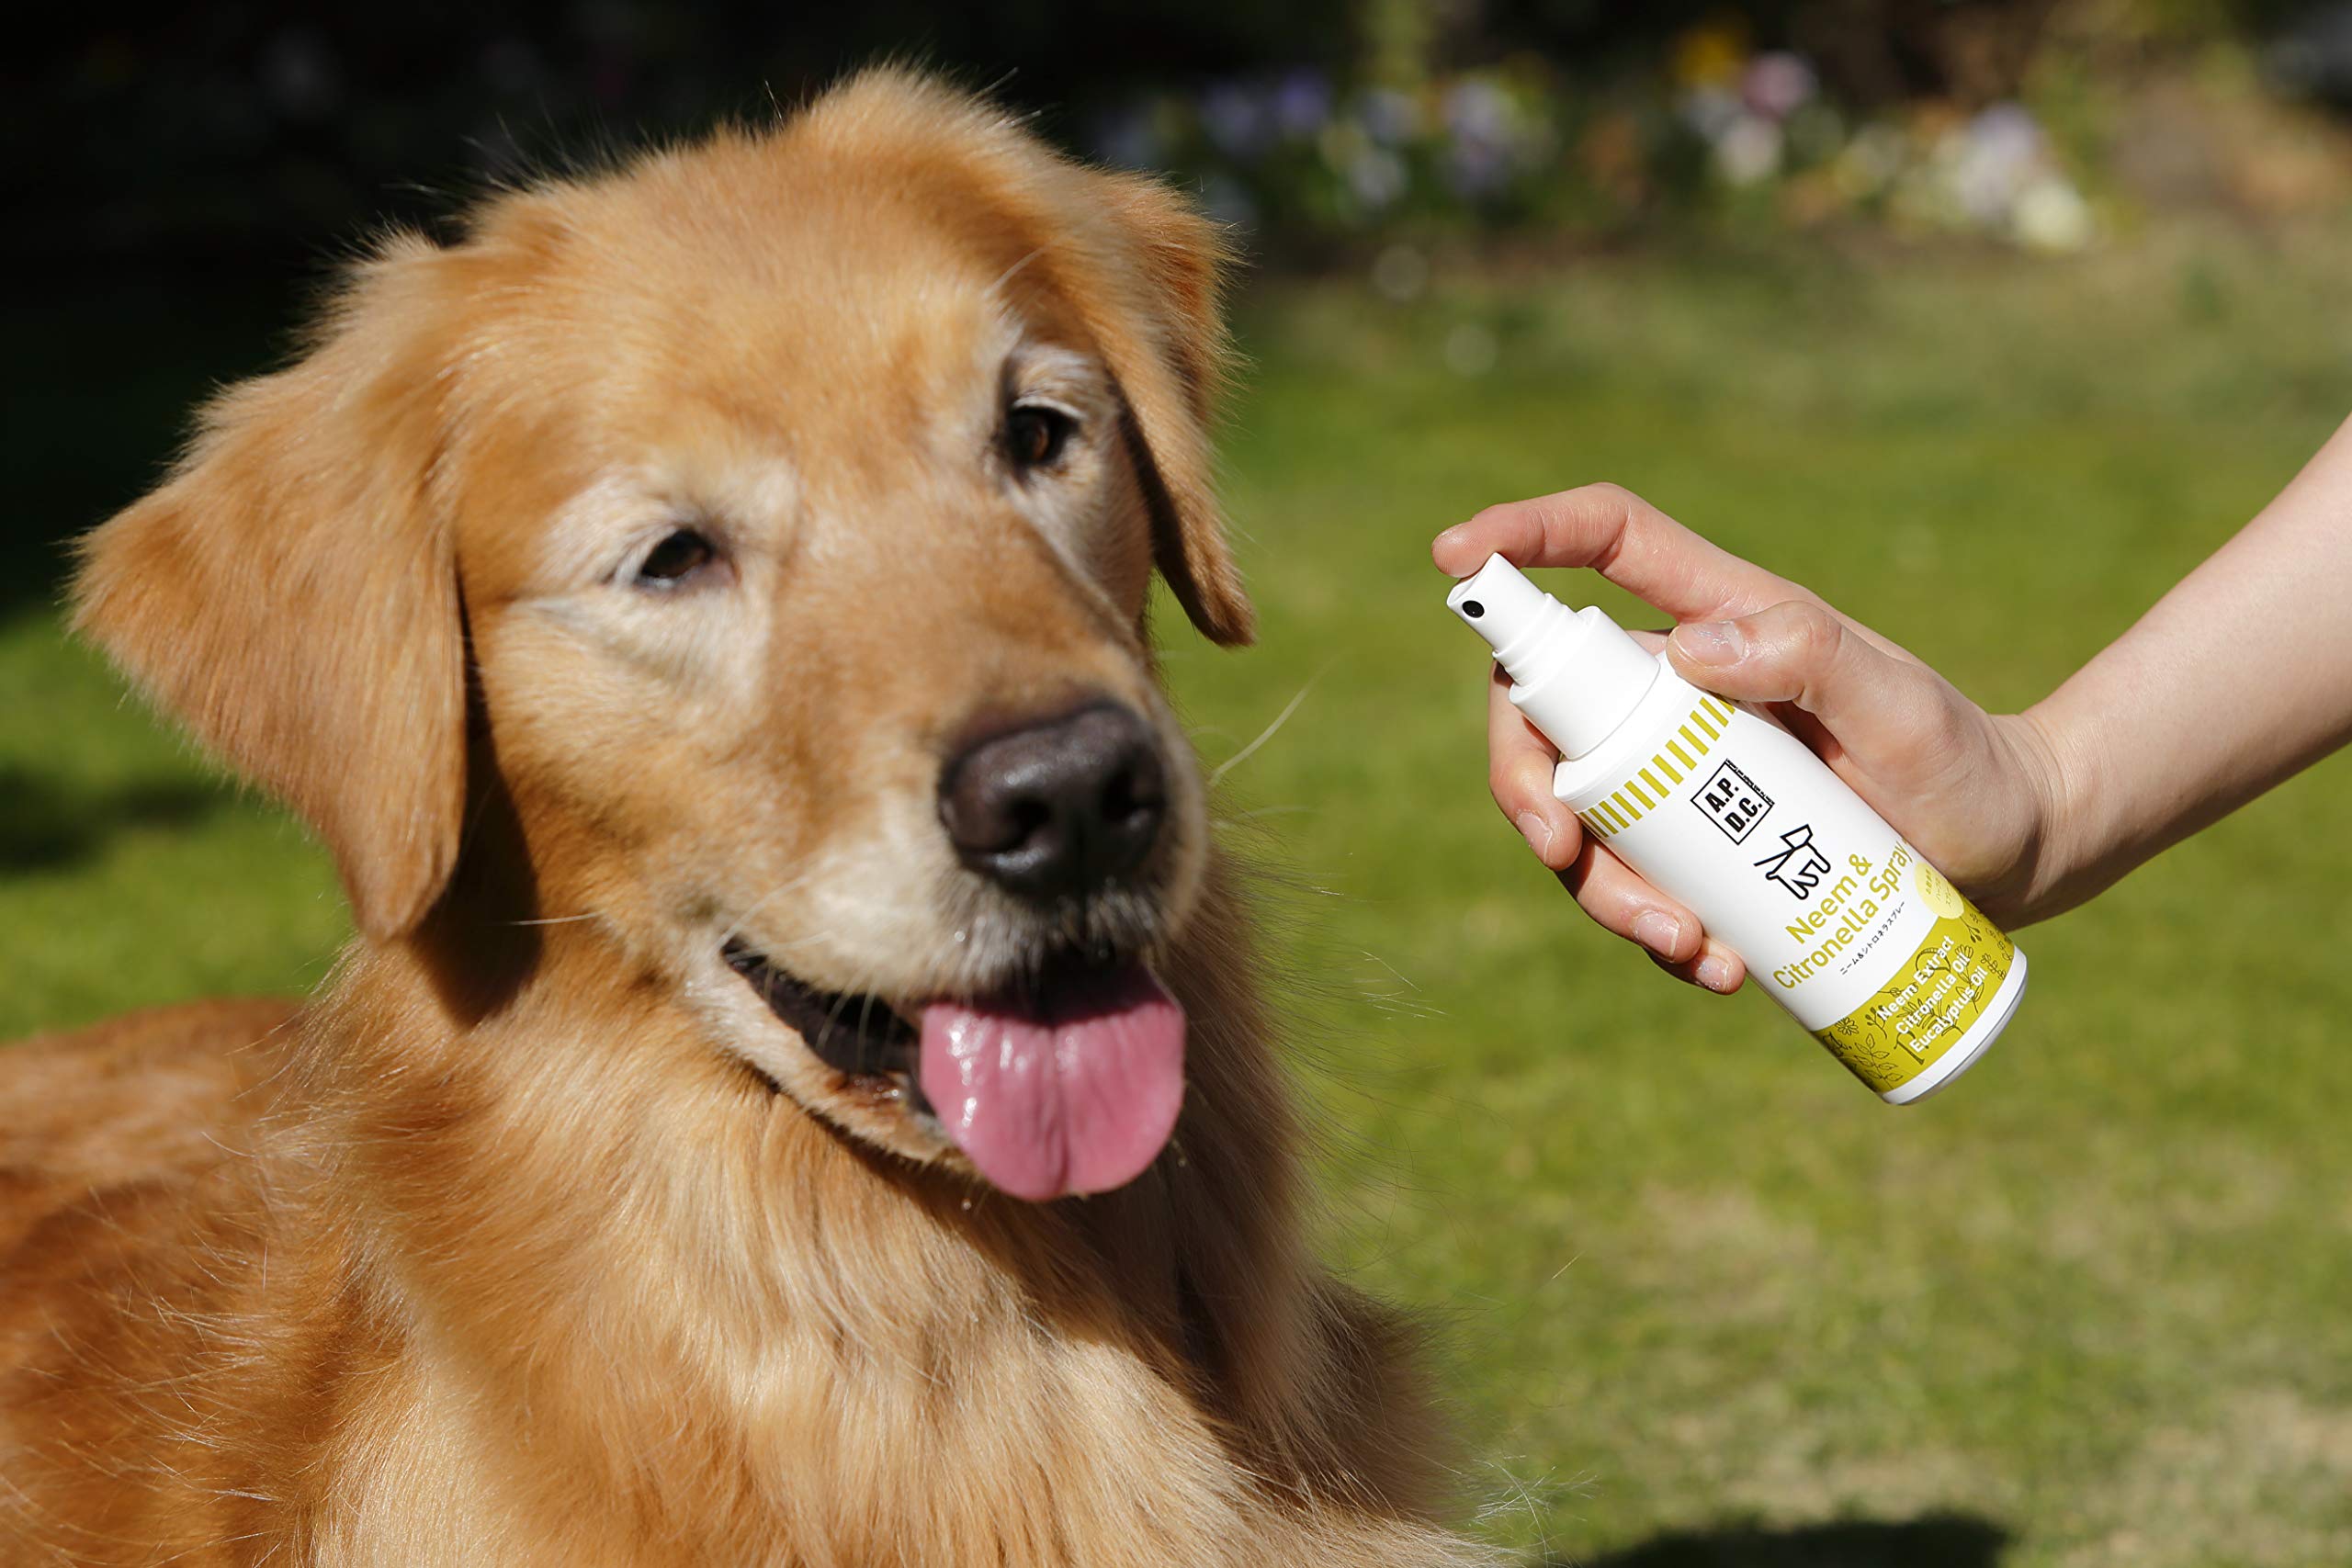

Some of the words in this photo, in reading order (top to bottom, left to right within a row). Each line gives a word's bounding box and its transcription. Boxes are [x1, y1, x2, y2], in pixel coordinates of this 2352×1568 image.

[1704, 777, 1739, 813] A.P.
[1724, 797, 1763, 833] D.C.
[1772, 898, 1880, 989] Citronella
[1869, 840, 1913, 901] Spray
[1785, 875, 1858, 944] Neem
[1849, 853, 1873, 876] &
[1876, 982, 1918, 1021] Neem
[1913, 935, 1955, 985] Extract
[1895, 975, 1957, 1035] Citronella
[1952, 952, 1971, 973] Oil
[1908, 987, 1975, 1054] Eucalyptus
[1971, 964, 1988, 987] Oil
